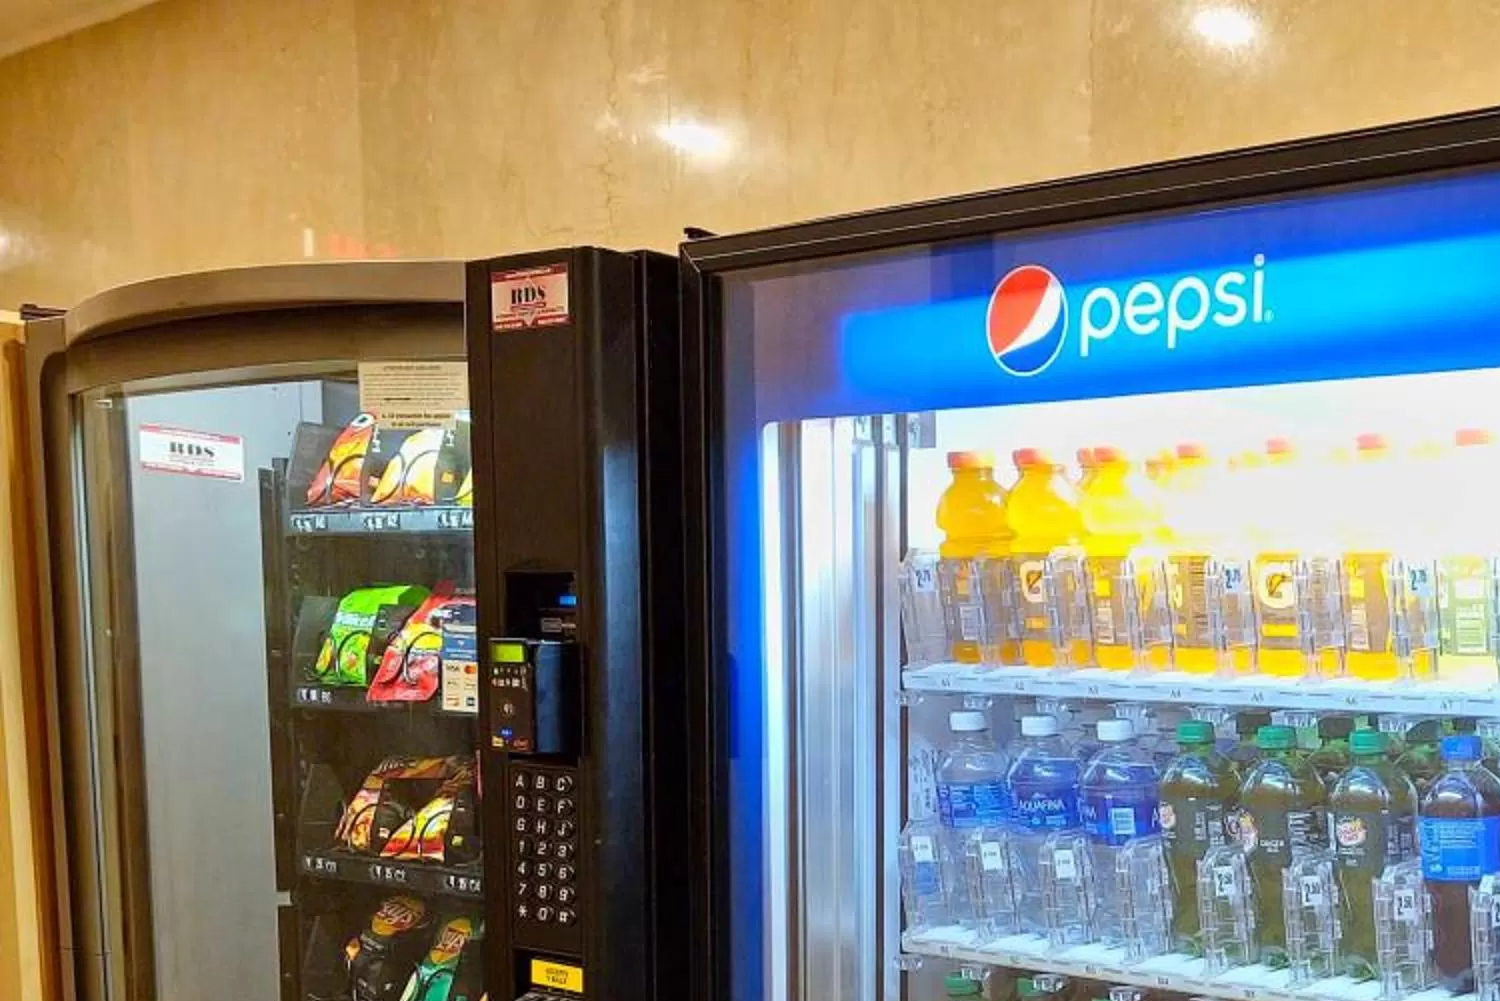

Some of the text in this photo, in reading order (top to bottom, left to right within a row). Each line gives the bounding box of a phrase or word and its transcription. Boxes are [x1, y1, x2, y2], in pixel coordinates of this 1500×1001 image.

[1079, 253, 1266, 357] pepsi
[515, 774, 565, 791] A B C
[515, 795, 565, 814] D E F
[516, 818, 566, 836] G H J
[519, 840, 567, 857] 1 2 3
[517, 862, 567, 879] 4 5 6
[518, 883, 568, 901] 7 8 9
[537, 907, 548, 921] 0
